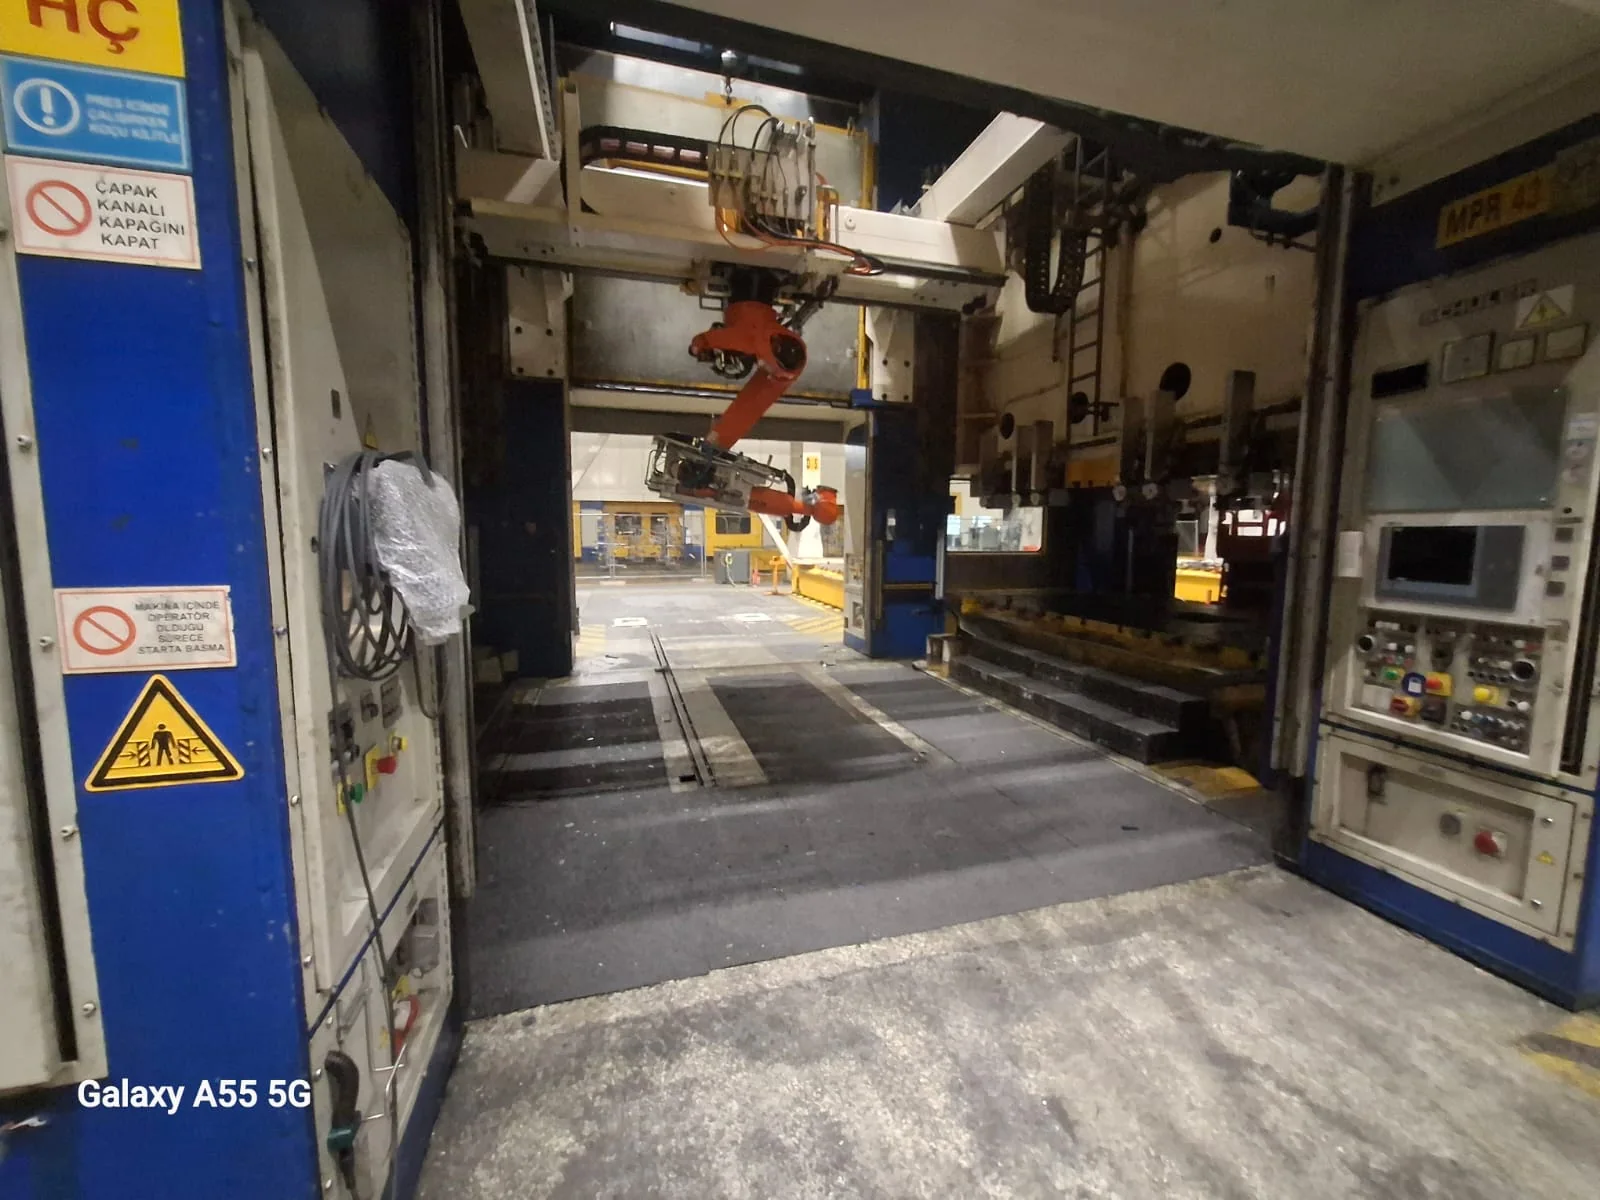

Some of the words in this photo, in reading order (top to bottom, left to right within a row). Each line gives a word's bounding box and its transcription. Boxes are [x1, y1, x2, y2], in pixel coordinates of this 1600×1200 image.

[97, 199, 165, 216] KANALI
[101, 233, 159, 249] KAPAT
[137, 645, 182, 654] STARTA
[185, 644, 225, 652] BASMA
